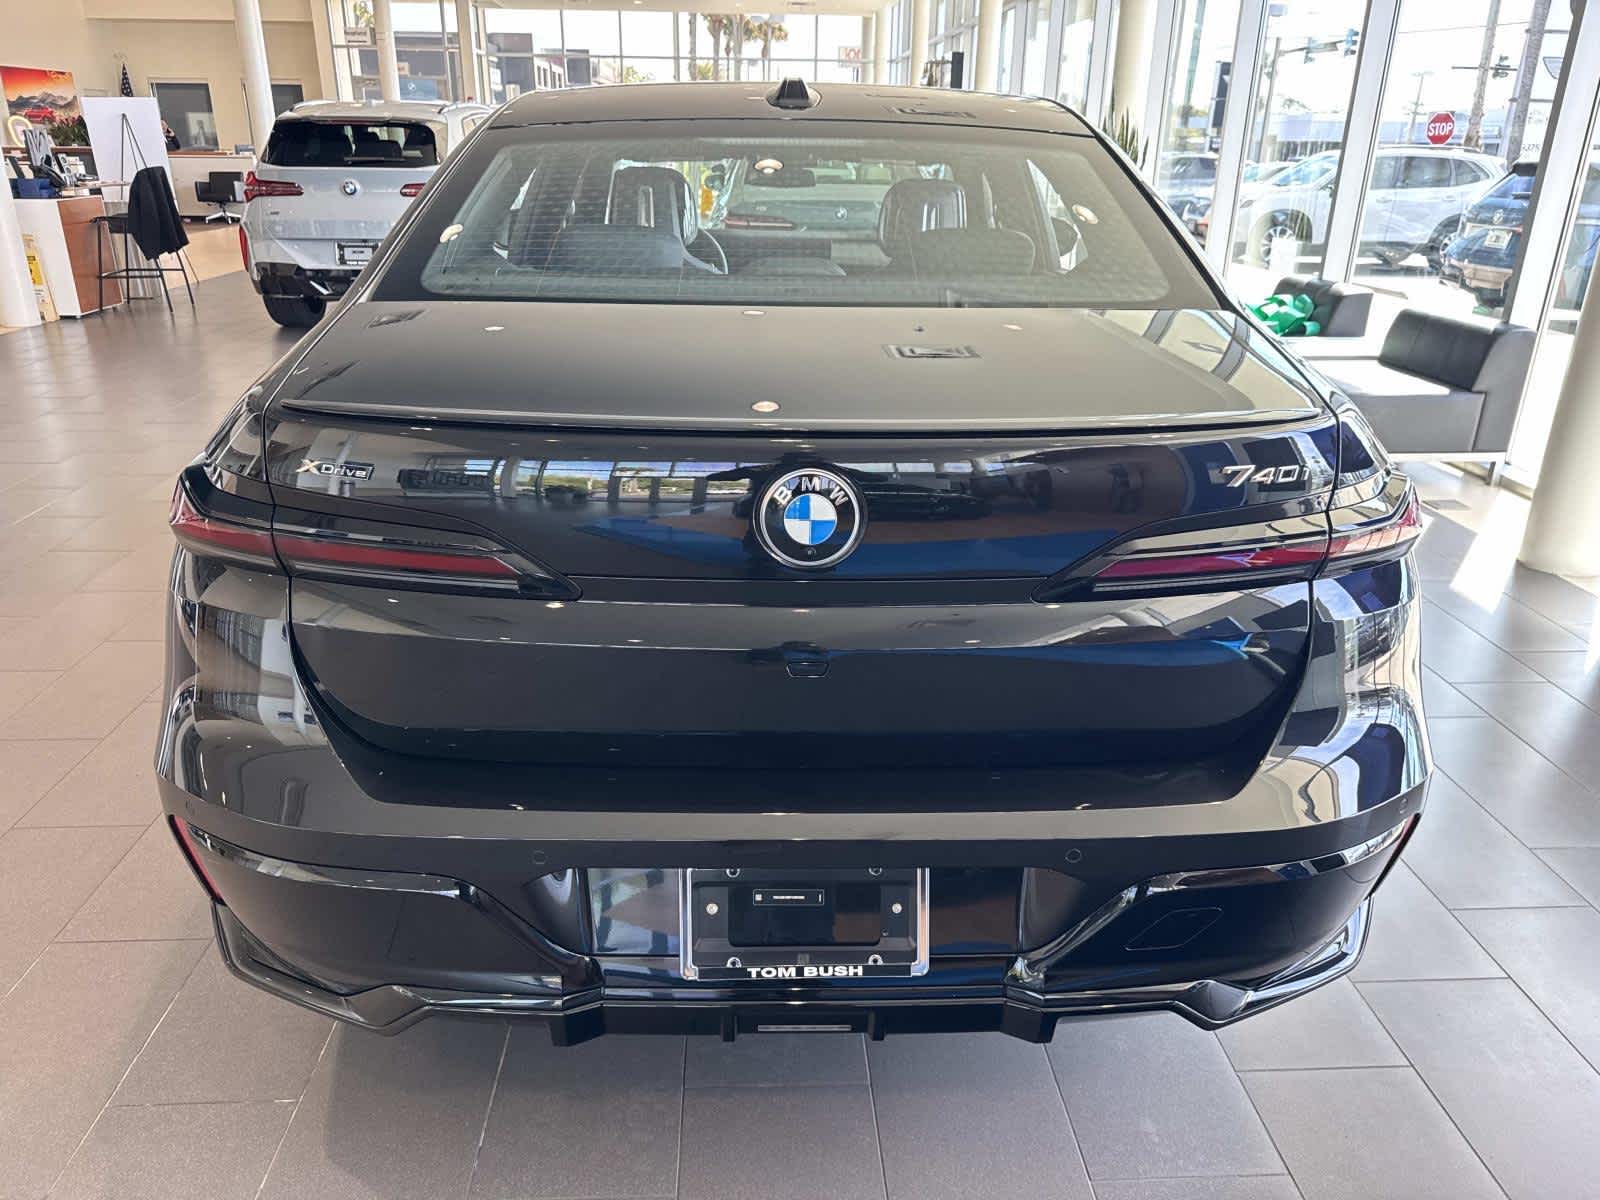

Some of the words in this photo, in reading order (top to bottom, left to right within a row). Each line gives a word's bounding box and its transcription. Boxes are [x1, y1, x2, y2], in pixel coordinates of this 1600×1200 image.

[1428, 122, 1453, 136] STOP
[1222, 464, 1310, 488] 740i
[773, 476, 848, 507] BMW
[747, 966, 797, 978] TOM
[803, 965, 863, 977] BUSH
